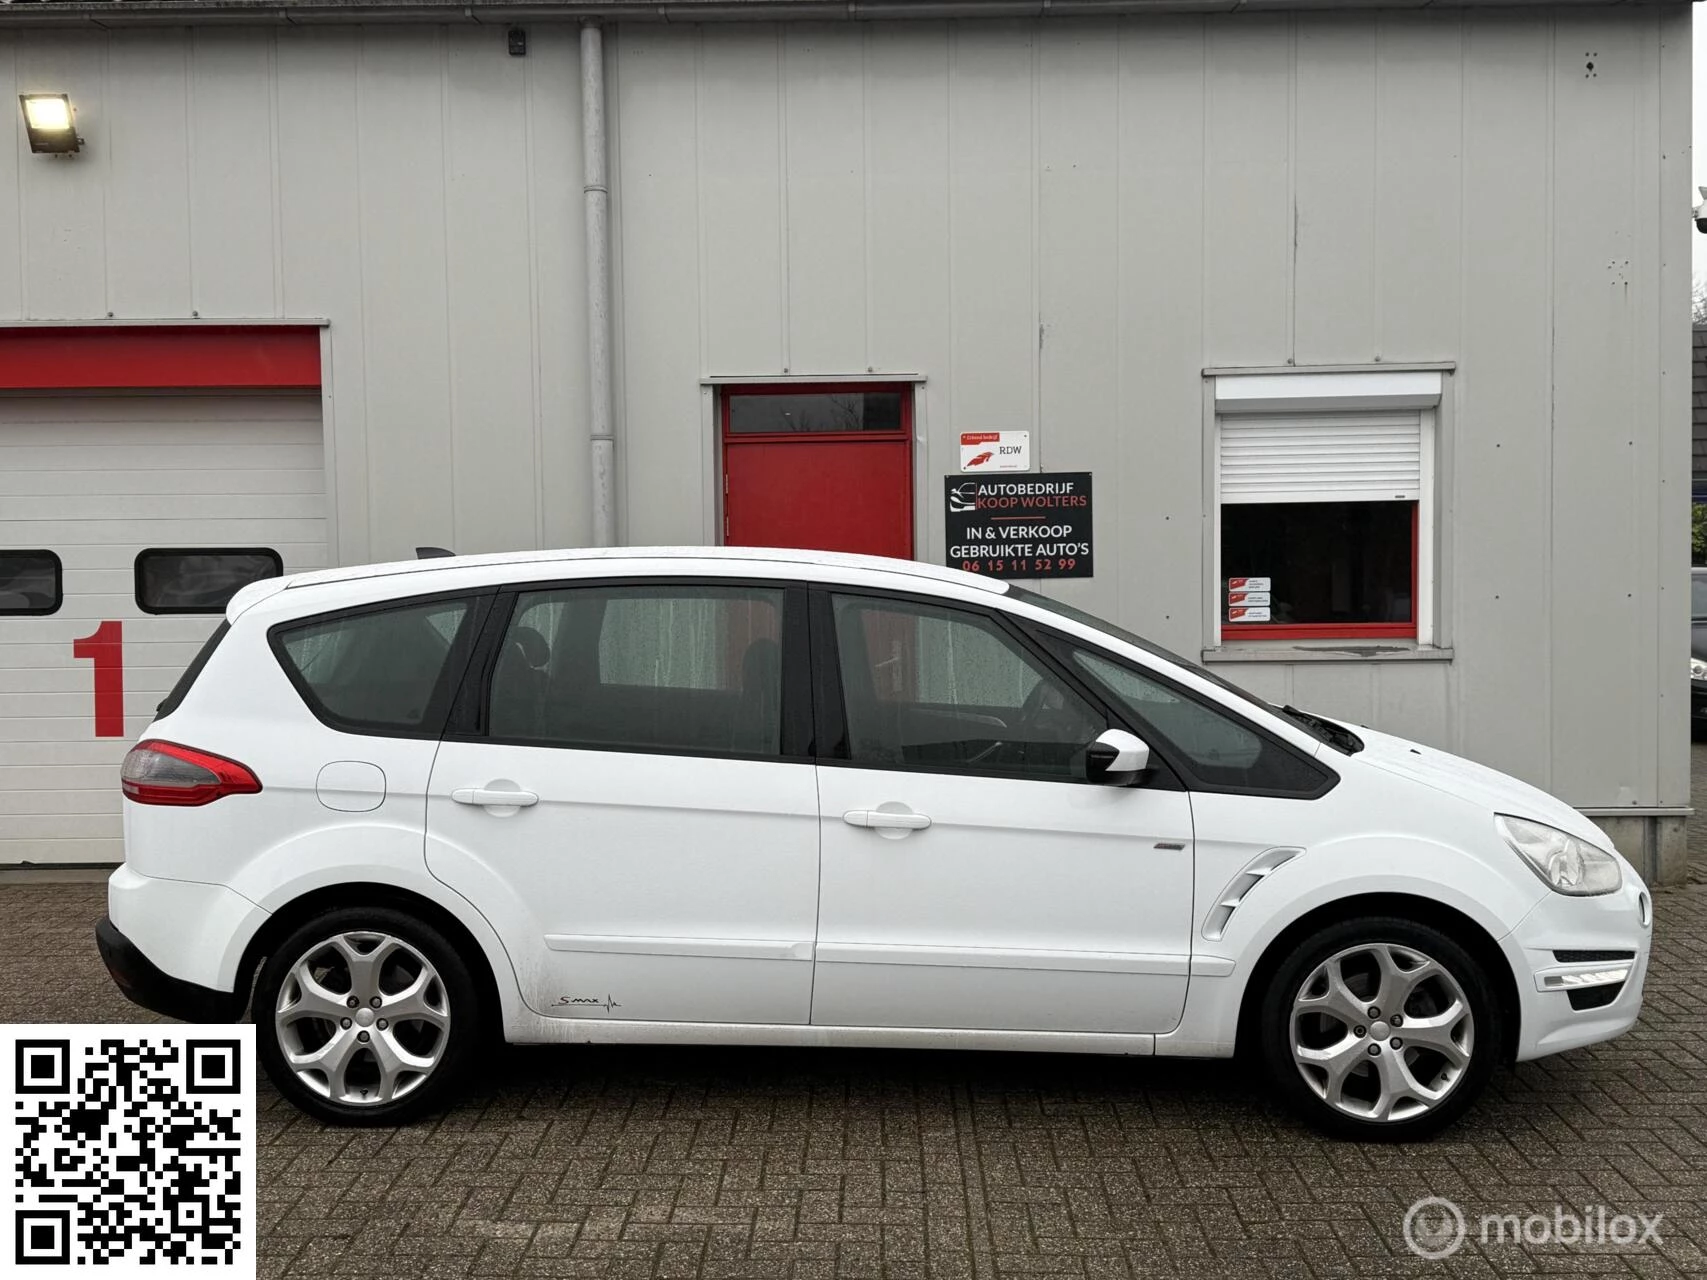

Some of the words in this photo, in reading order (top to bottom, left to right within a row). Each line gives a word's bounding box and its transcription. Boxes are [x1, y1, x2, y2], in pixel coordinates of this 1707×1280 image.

[999, 446, 1022, 455] RDW
[978, 482, 1074, 496] AUTOBEDRIJF
[978, 497, 1018, 509] KOOP
[1021, 495, 1087, 508] WOLTERS
[966, 527, 982, 540] IN
[985, 527, 996, 539] &
[999, 525, 1073, 539] VERKOOP
[950, 544, 1033, 558] GEBRUIKTE
[1035, 542, 1090, 557] AUTO'S
[962, 560, 980, 572] 06
[987, 560, 1004, 571] 15
[1011, 559, 1027, 571] 11
[1035, 559, 1052, 571] 52
[1058, 558, 1076, 570] 99
[73, 620, 124, 737] 1
